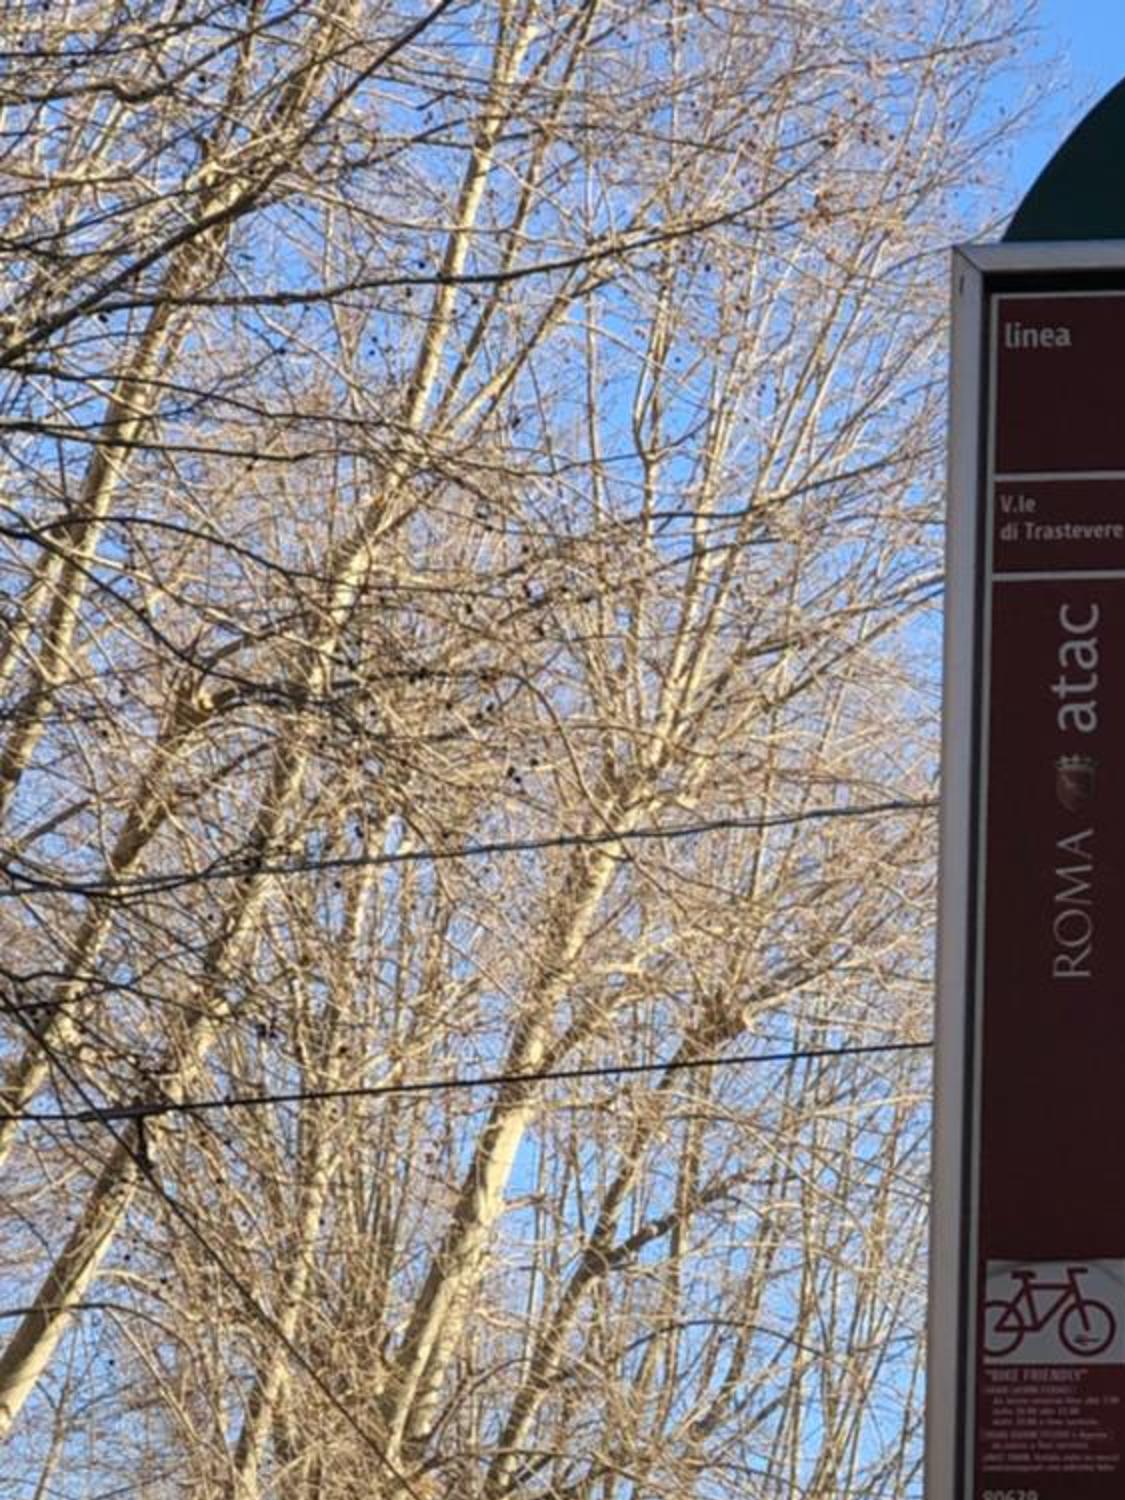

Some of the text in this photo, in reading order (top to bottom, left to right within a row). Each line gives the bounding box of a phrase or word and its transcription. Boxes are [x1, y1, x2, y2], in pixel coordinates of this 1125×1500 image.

[1004, 322, 1072, 349] linea
[1001, 495, 1036, 514] V.le
[1001, 519, 1123, 541] di Trastevere
[1051, 604, 1099, 732] atac
[1052, 828, 1094, 978] ROMA
